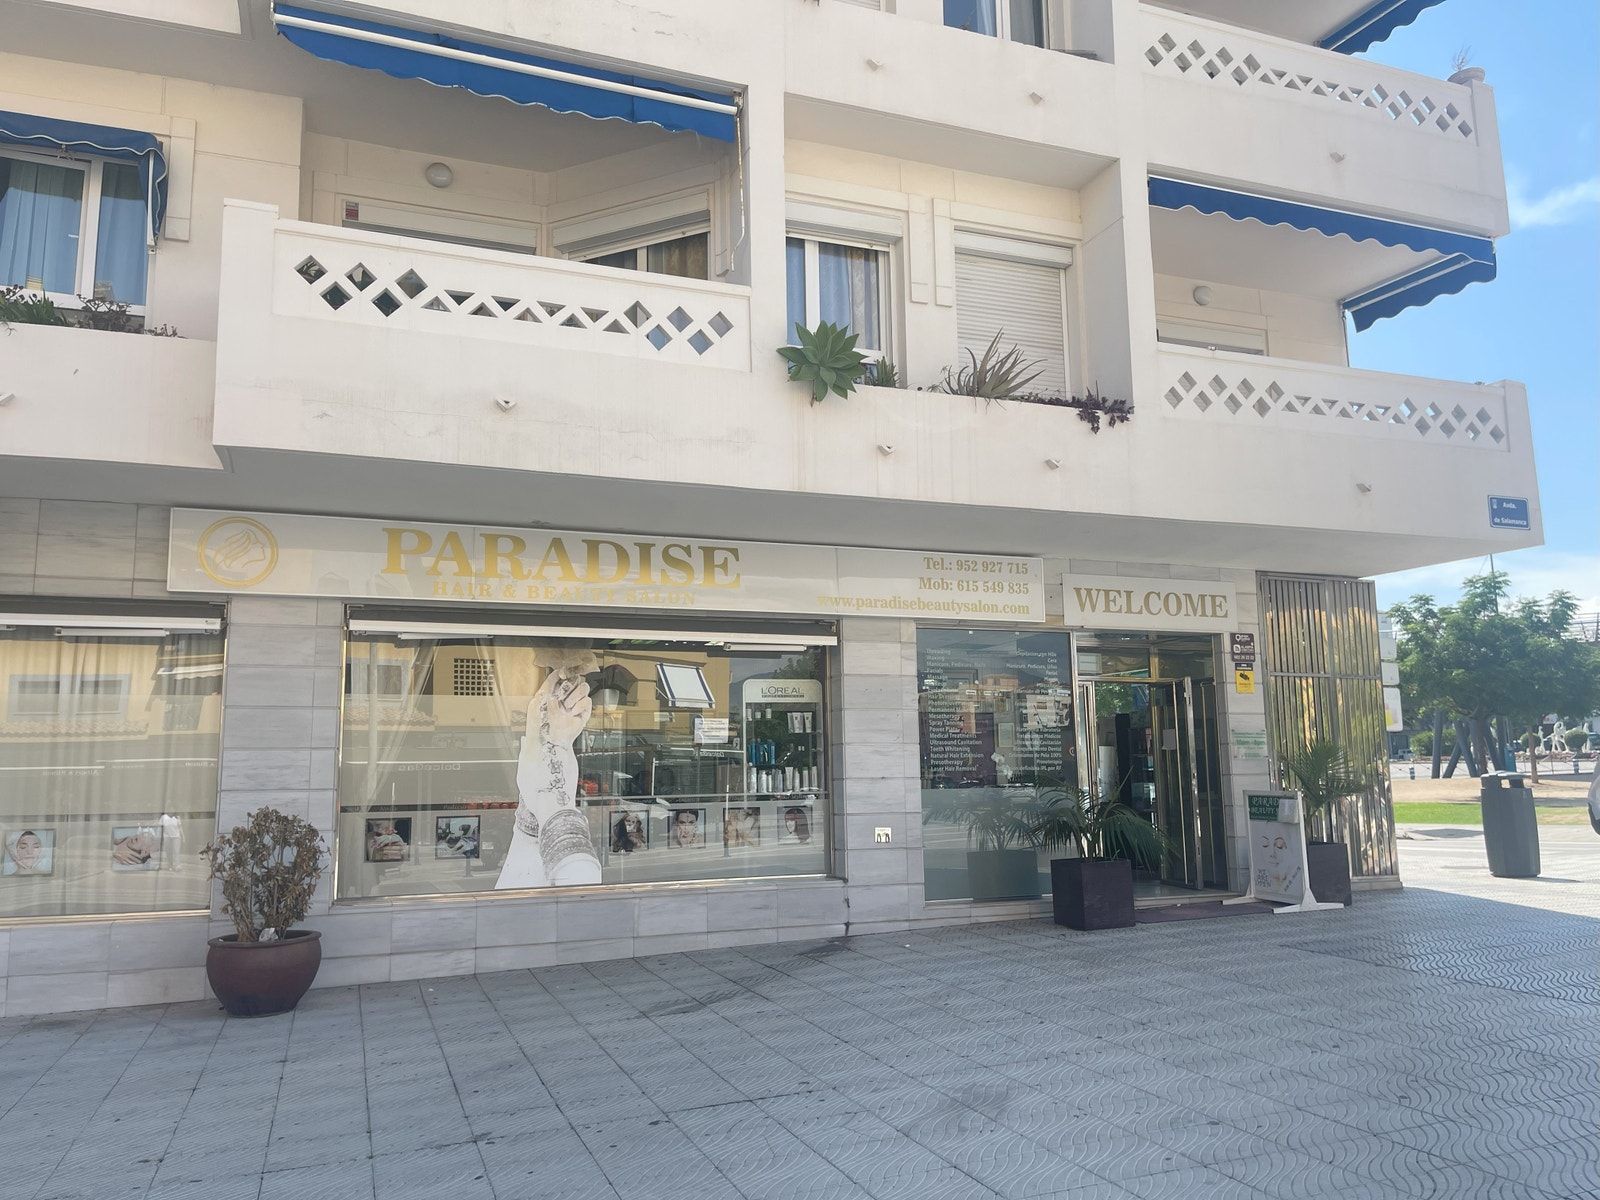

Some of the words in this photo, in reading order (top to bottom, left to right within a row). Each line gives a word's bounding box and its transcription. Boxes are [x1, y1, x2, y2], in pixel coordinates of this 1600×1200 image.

[1501, 517, 1527, 526] Salamanca
[381, 527, 740, 589] PARADISE
[923, 557, 952, 571] Tel.:
[956, 559, 978, 573] 952
[982, 560, 1003, 574] 927
[1008, 562, 1029, 575] 715
[433, 581, 493, 598] HAIR
[503, 584, 517, 599] &
[527, 584, 617, 603] BEAUTY
[626, 589, 697, 606] SALON
[918, 577, 953, 591] Mob:
[957, 579, 978, 592] 615
[982, 580, 1004, 593] 549
[1008, 582, 1029, 595] 835
[817, 595, 1030, 615] www.paradisebeautysalon.com
[1073, 587, 1229, 619] WELCOME
